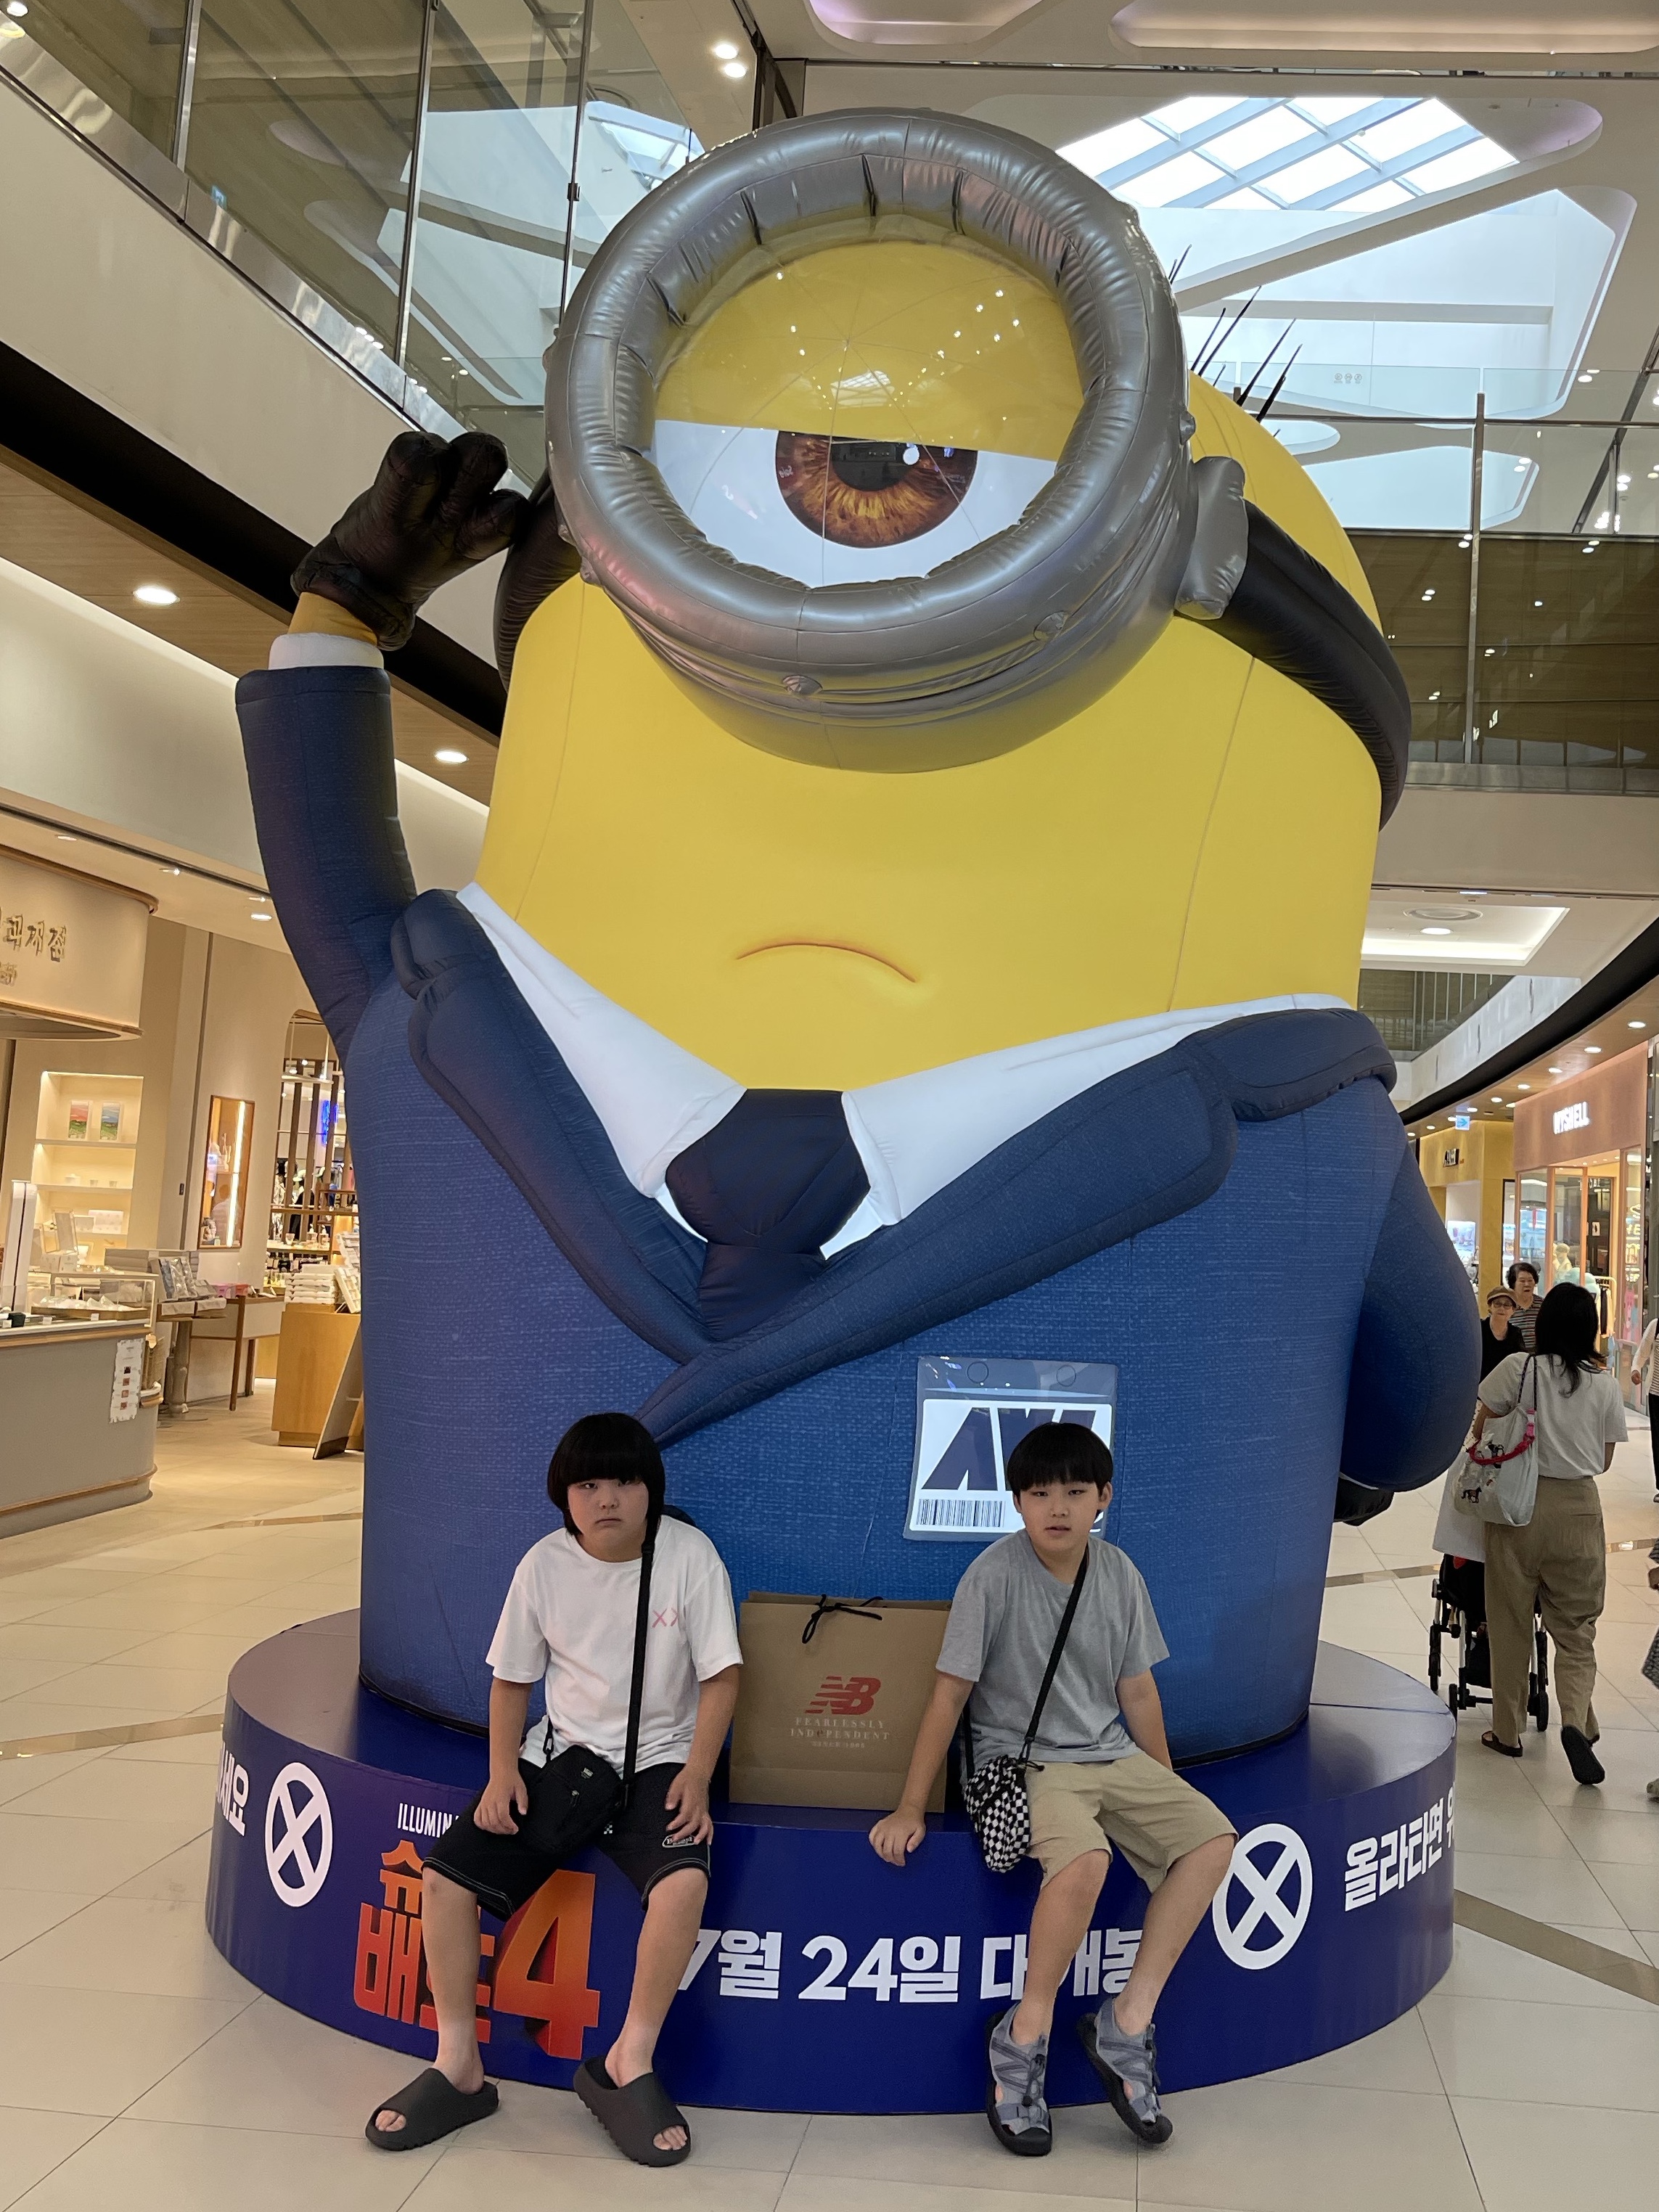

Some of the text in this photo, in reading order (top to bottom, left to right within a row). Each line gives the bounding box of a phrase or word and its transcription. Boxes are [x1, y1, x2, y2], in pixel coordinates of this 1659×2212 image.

[805, 1675, 881, 1716] NB
[795, 1717, 884, 1729] FEARLESSLY
[398, 1803, 459, 1838] ILLUMIN
[1345, 1798, 1443, 1912] 올라타면
[678, 1929, 782, 1999] 7월
[798, 1936, 961, 2003] 24일
